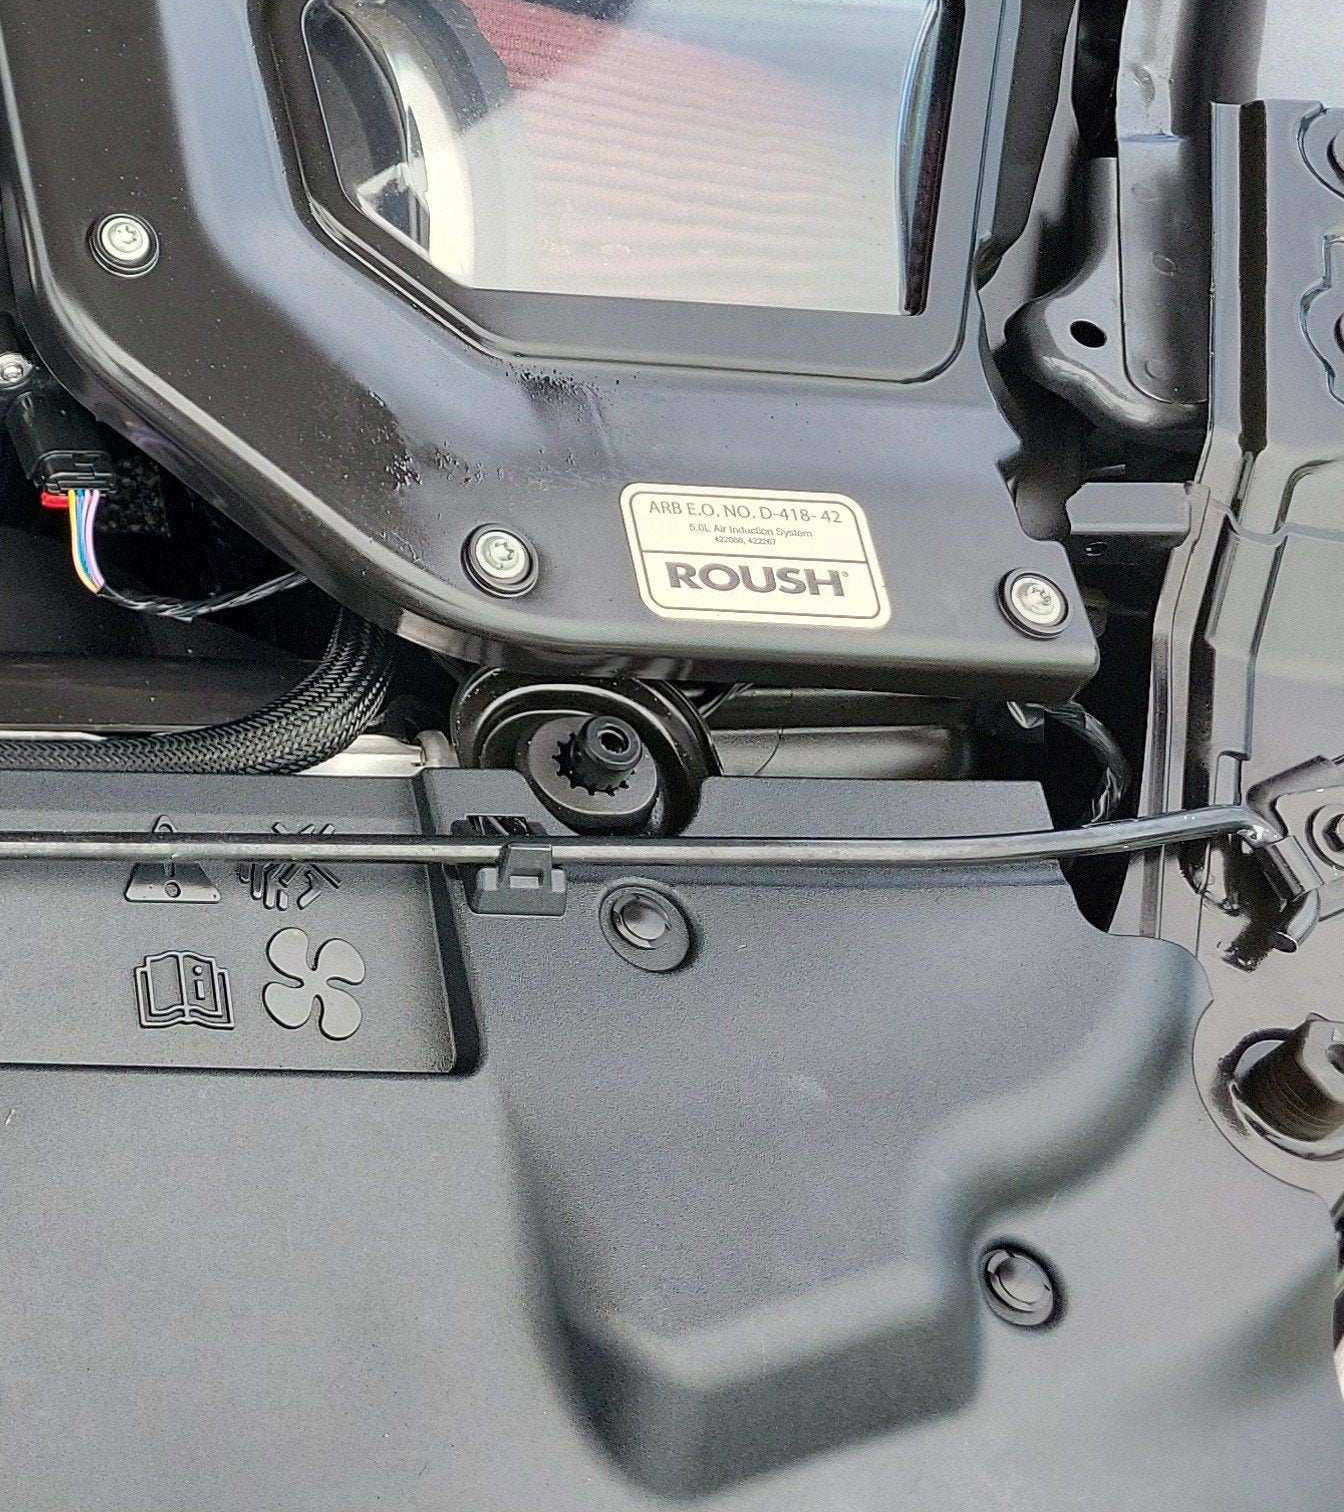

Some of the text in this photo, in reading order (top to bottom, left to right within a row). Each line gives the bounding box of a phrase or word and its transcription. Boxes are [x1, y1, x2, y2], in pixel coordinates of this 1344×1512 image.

[649, 500, 683, 516] ARB
[686, 502, 720, 518] E.O.
[723, 503, 756, 520] NO.
[713, 524, 726, 534] Air
[729, 525, 774, 536] Induction
[776, 527, 813, 539] System
